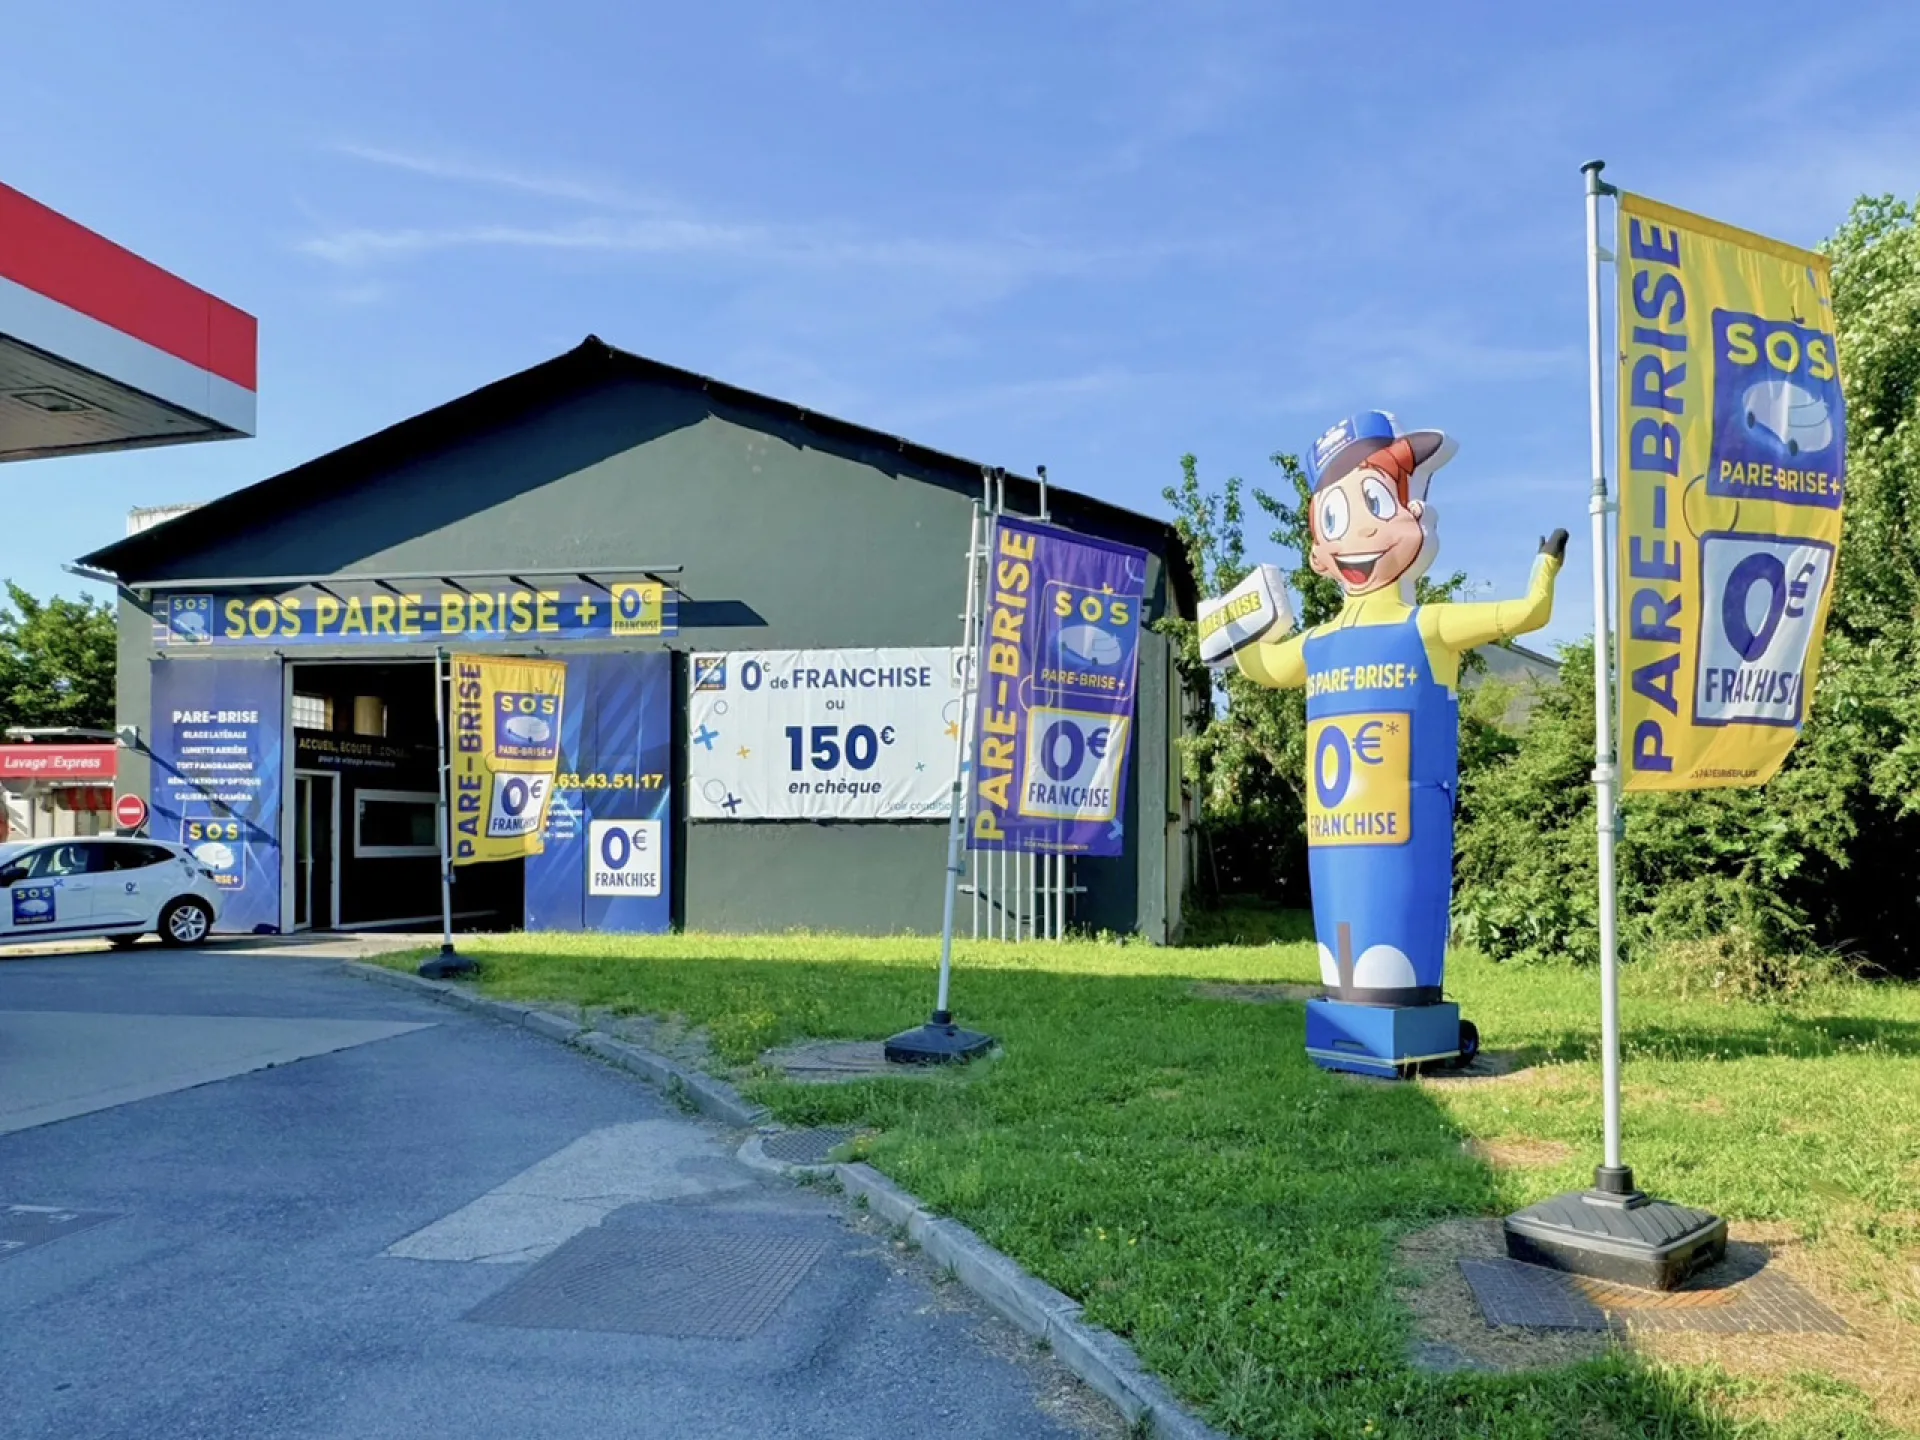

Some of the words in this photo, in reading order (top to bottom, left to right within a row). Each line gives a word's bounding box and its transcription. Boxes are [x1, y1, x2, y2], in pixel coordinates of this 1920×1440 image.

[1726, 323, 1834, 381] SOS
[1630, 217, 1688, 772] PARE-BRISE
[174, 598, 208, 611] SOS
[225, 596, 302, 639] SOS
[315, 590, 561, 637] PARE-BRISE
[1053, 591, 1131, 625] SOS
[1721, 552, 1815, 663] 0€
[770, 675, 789, 690] de
[792, 667, 932, 689] FRANCHISE
[973, 529, 1036, 841] PARE-BRISE
[173, 710, 259, 724] PARE-BRISE
[500, 695, 555, 715] SOS
[825, 700, 845, 711] ou
[458, 662, 482, 858] PARE-BRISE
[784, 724, 896, 772] 150€
[1040, 719, 1111, 782] 0€
[5, 755, 48, 771] Lavage
[53, 755, 102, 771] Express
[553, 773, 664, 789] .63.43.51.17
[788, 781, 811, 795] en
[815, 778, 883, 800] chèque
[501, 777, 544, 817] 0€
[1028, 782, 1110, 808] FRANCHISE
[189, 822, 239, 841] SOS
[1310, 812, 1398, 838] FRANCHISE
[601, 826, 648, 871] 0€
[594, 872, 657, 887] FRANCHISE
[15, 887, 51, 900] SOS
